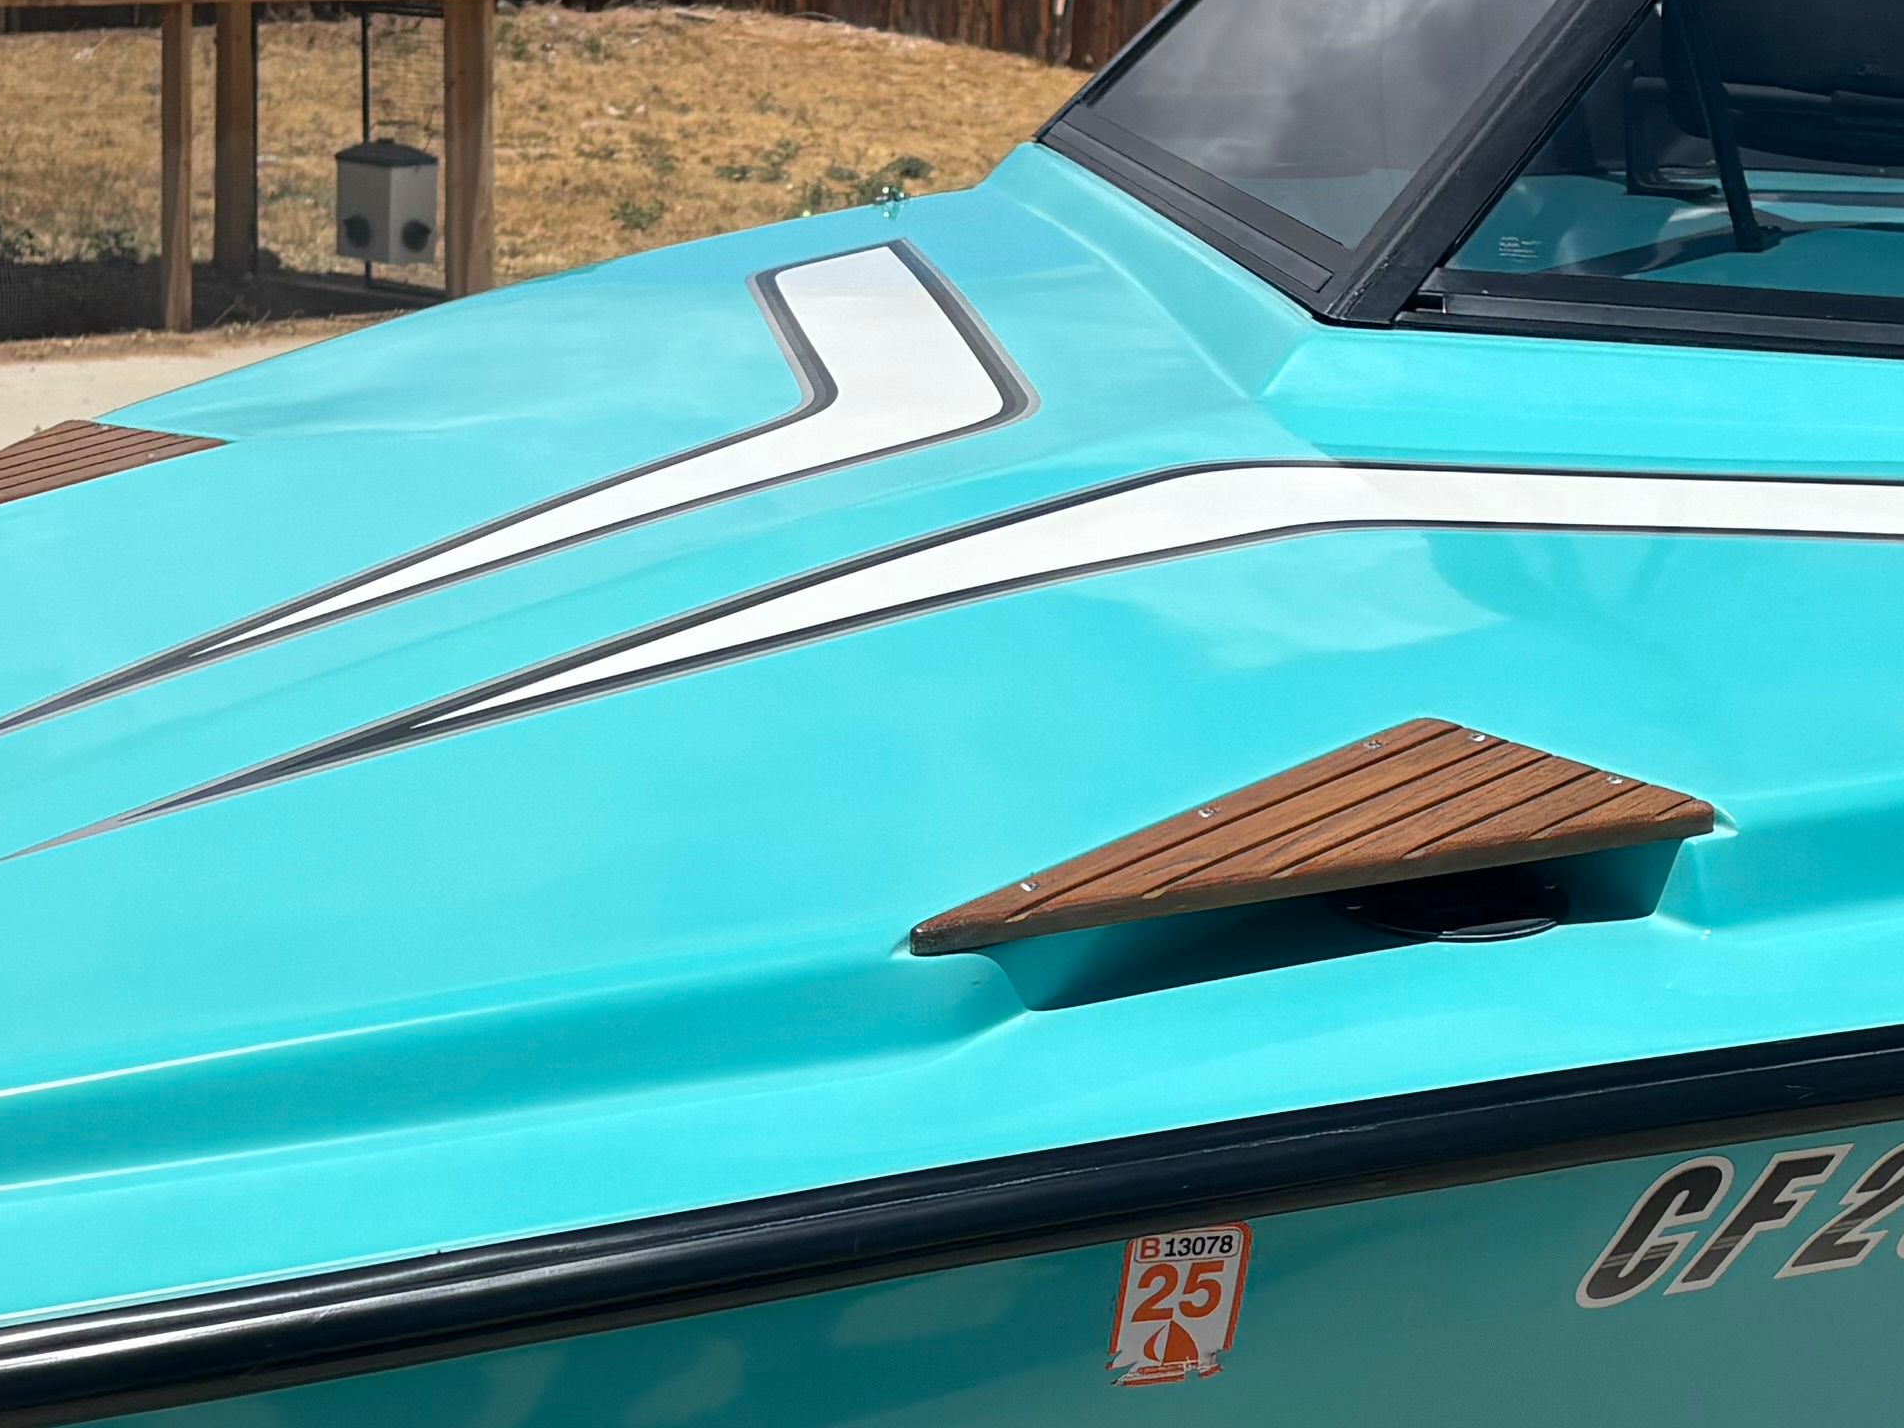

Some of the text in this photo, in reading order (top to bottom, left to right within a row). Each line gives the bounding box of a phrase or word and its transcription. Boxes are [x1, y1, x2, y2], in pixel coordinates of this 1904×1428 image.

[1140, 1235, 1234, 1259] B 13078
[1131, 1260, 1225, 1323] 25
